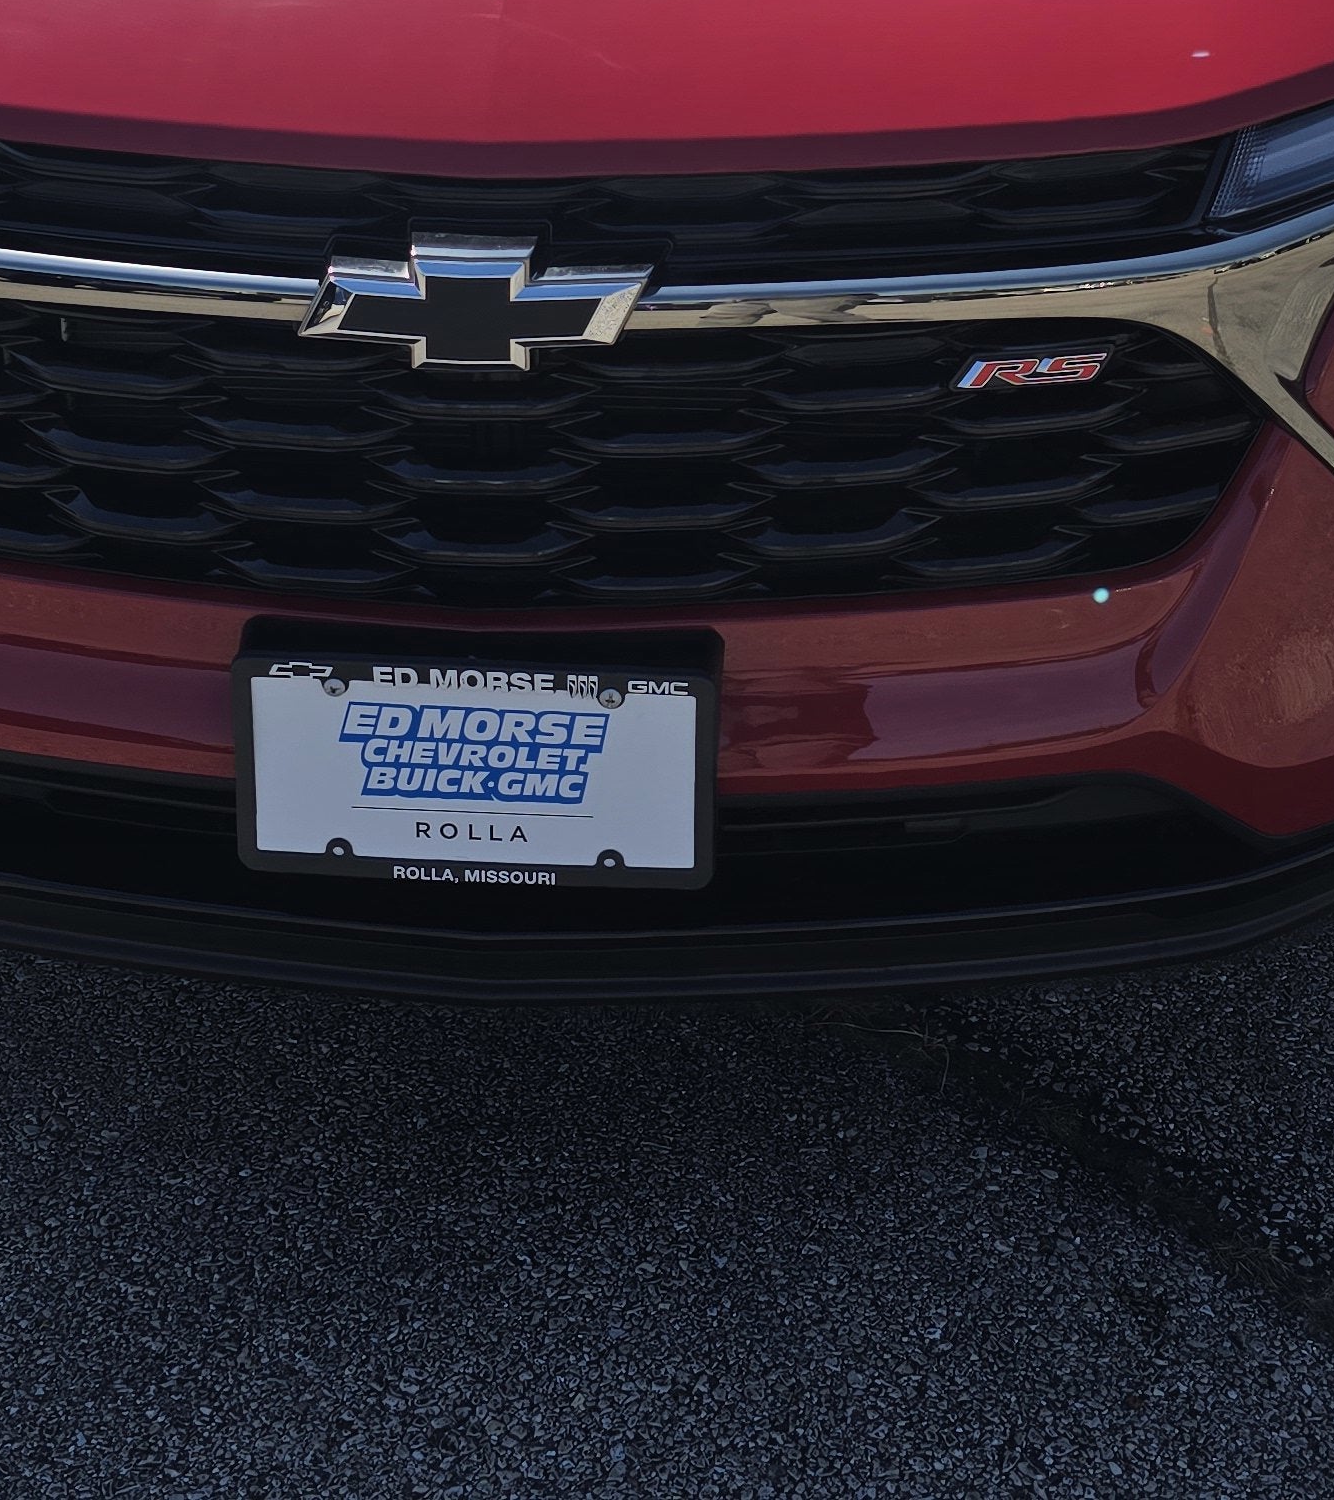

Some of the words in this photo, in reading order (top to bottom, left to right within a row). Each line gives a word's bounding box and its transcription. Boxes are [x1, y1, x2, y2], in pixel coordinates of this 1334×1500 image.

[957, 353, 1107, 389] RS
[372, 666, 419, 688] ED
[429, 668, 556, 693] MORSE
[627, 680, 689, 696] GMC
[343, 705, 414, 736] ED
[416, 708, 605, 746] MORSE
[415, 821, 529, 843] ROLLA
[393, 865, 460, 884] ROLLA,
[464, 868, 556, 886] MISSOURI
